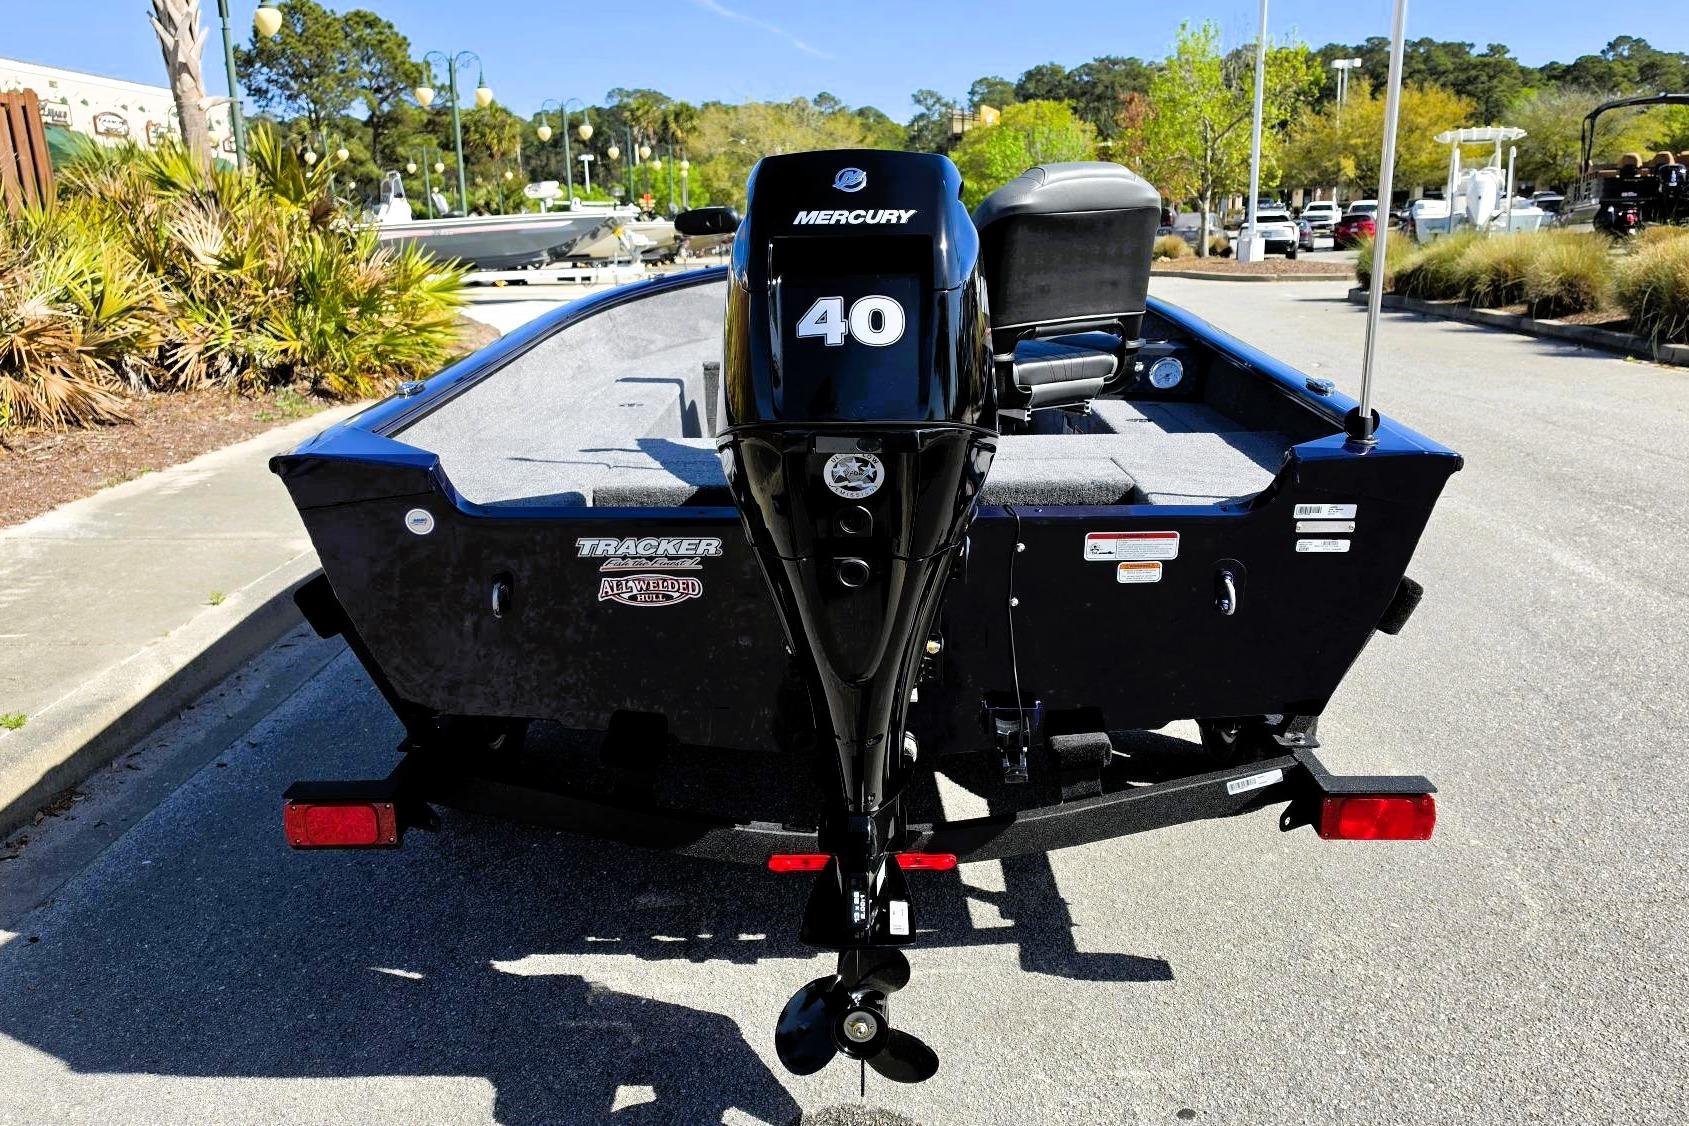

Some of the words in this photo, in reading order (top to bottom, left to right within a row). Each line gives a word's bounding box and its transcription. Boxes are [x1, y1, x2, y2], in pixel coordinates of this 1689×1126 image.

[793, 209, 918, 225] MERCURY
[796, 294, 906, 347] 40
[576, 537, 722, 557] TRACKER
[604, 557, 629, 567] Fish
[631, 557, 651, 567] the
[601, 578, 632, 598] ALL
[633, 578, 699, 597] WELDED
[637, 593, 666, 602] HULL
